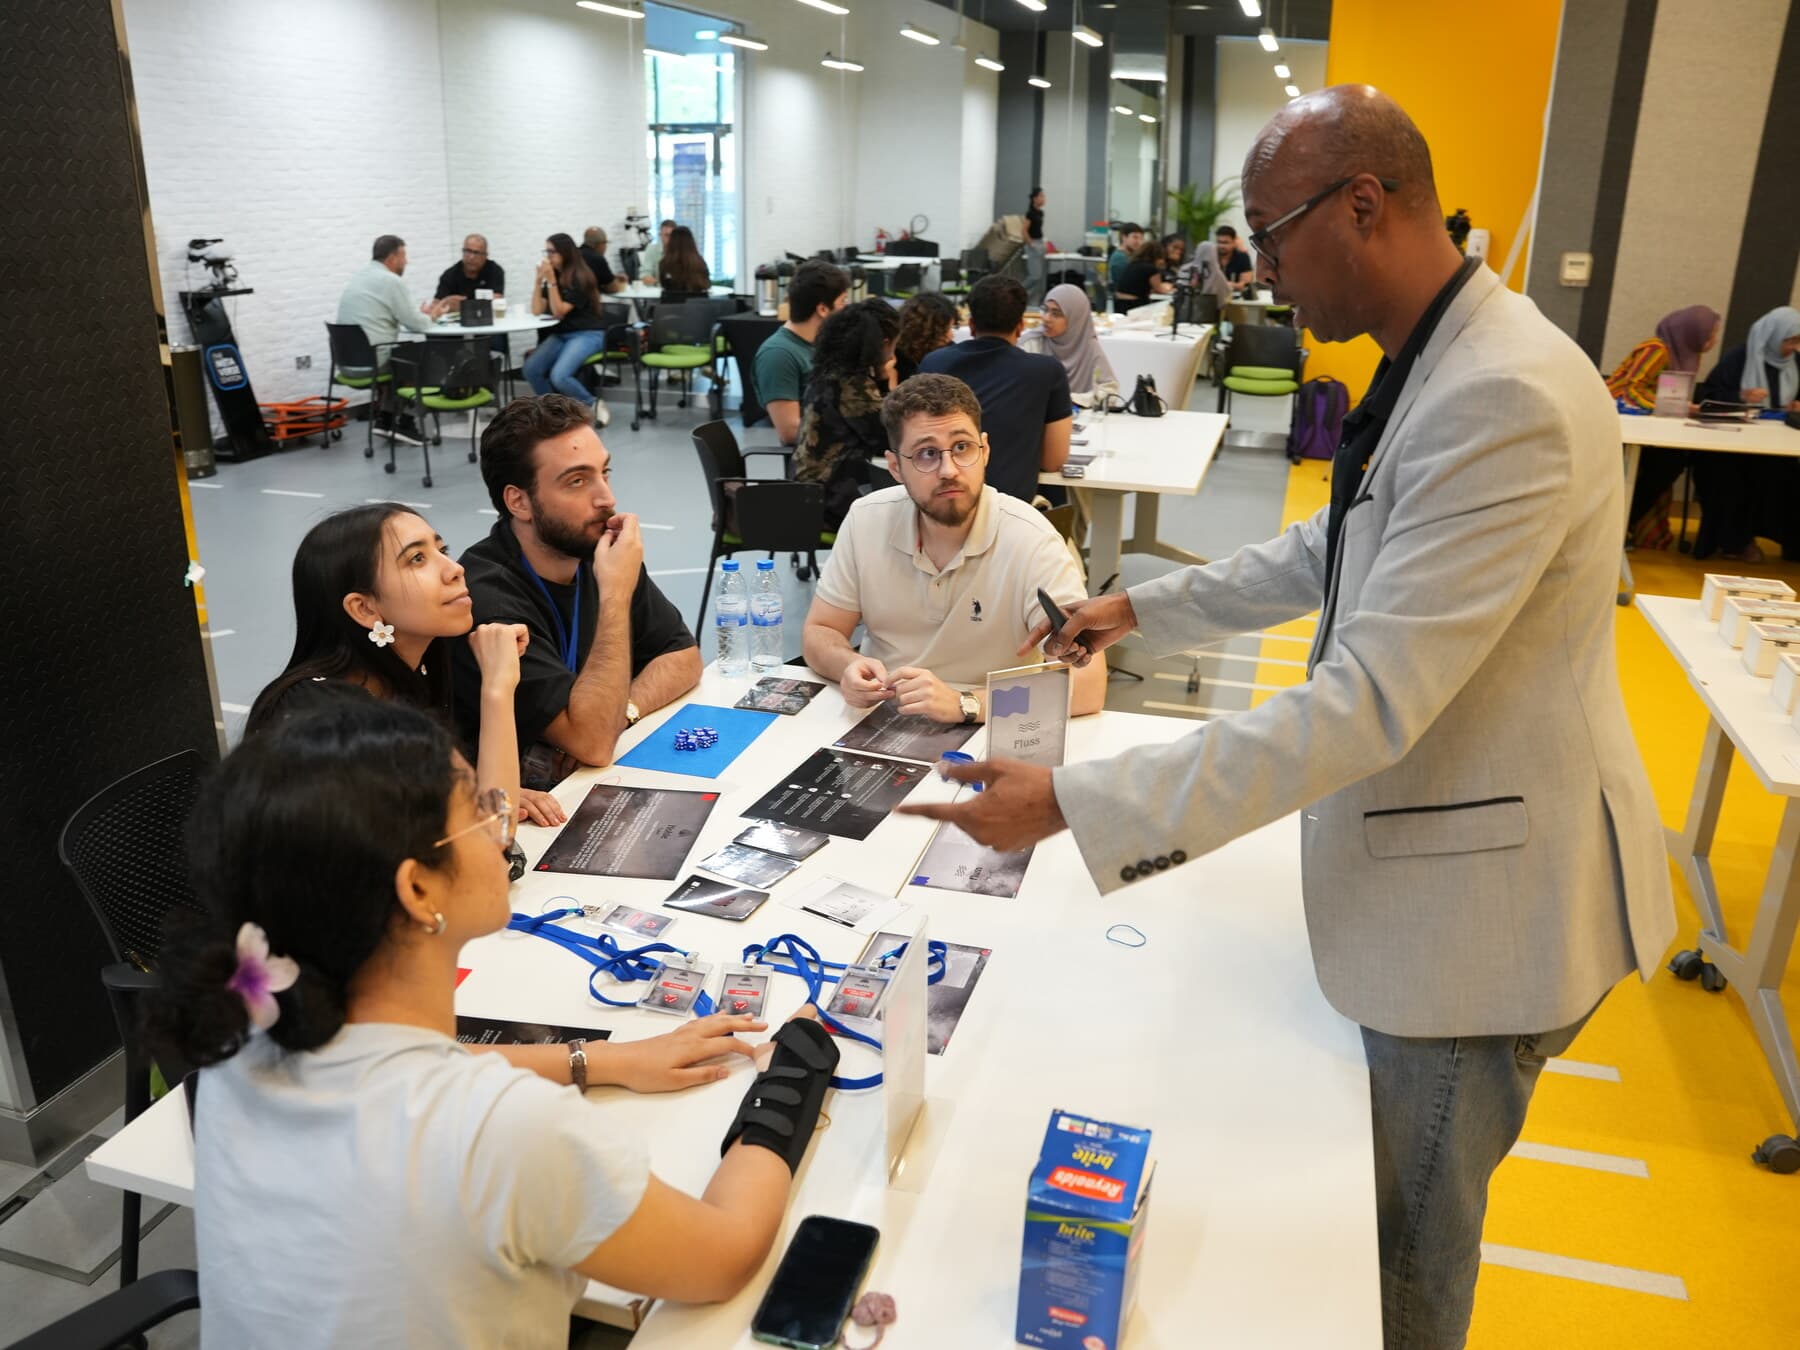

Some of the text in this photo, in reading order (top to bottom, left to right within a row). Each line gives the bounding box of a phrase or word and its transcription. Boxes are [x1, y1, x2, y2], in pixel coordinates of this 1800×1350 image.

[1014, 737, 1041, 749] Fluss
[1072, 1148, 1115, 1171] brite
[1054, 1170, 1122, 1199] Reynolds
[1058, 1222, 1096, 1241] brite
